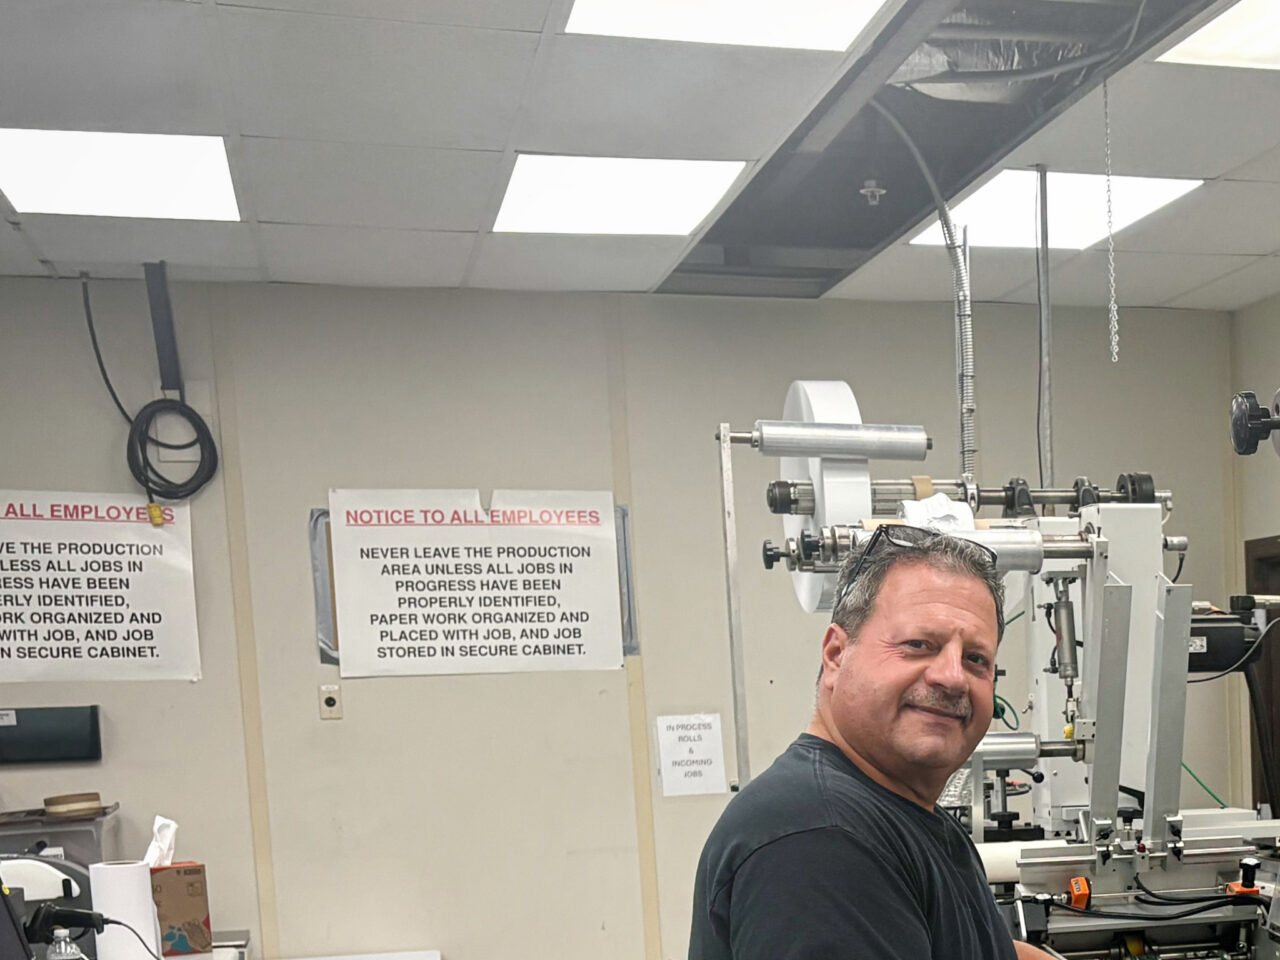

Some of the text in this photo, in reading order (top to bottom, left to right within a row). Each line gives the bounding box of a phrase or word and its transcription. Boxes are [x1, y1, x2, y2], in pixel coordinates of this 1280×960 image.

[4, 503, 175, 522] ALL EMPLOYES
[345, 509, 600, 525] NOTICE TO ALL EMPLOYEES
[0, 542, 163, 556] E THE PRODUCTION
[360, 546, 591, 559] NEVER LEAVE THE PRODUCTION
[0, 559, 143, 573] LESS ALL JOBS IN
[381, 562, 573, 576] AREA UNLESS ALL JOBS IN
[0, 577, 130, 590] ESS HAVE BEEN
[395, 579, 561, 592] PROGRESS HAVE BEEN
[0, 594, 130, 609] RLY IDENTIFIED,
[398, 596, 561, 609] PROPERLY IDENTIFIED,
[0, 612, 162, 625] RK ORGANIZED AND
[370, 611, 589, 626] PAPER WORK ORGANIZED AND
[0, 629, 154, 643] WITH JOB, AND JOB
[380, 627, 582, 642] PLACED WITH JOB, AND JOB
[0, 646, 160, 659] N SECURE CABINET.
[377, 643, 586, 659] STORED IN SECURE CABINET.
